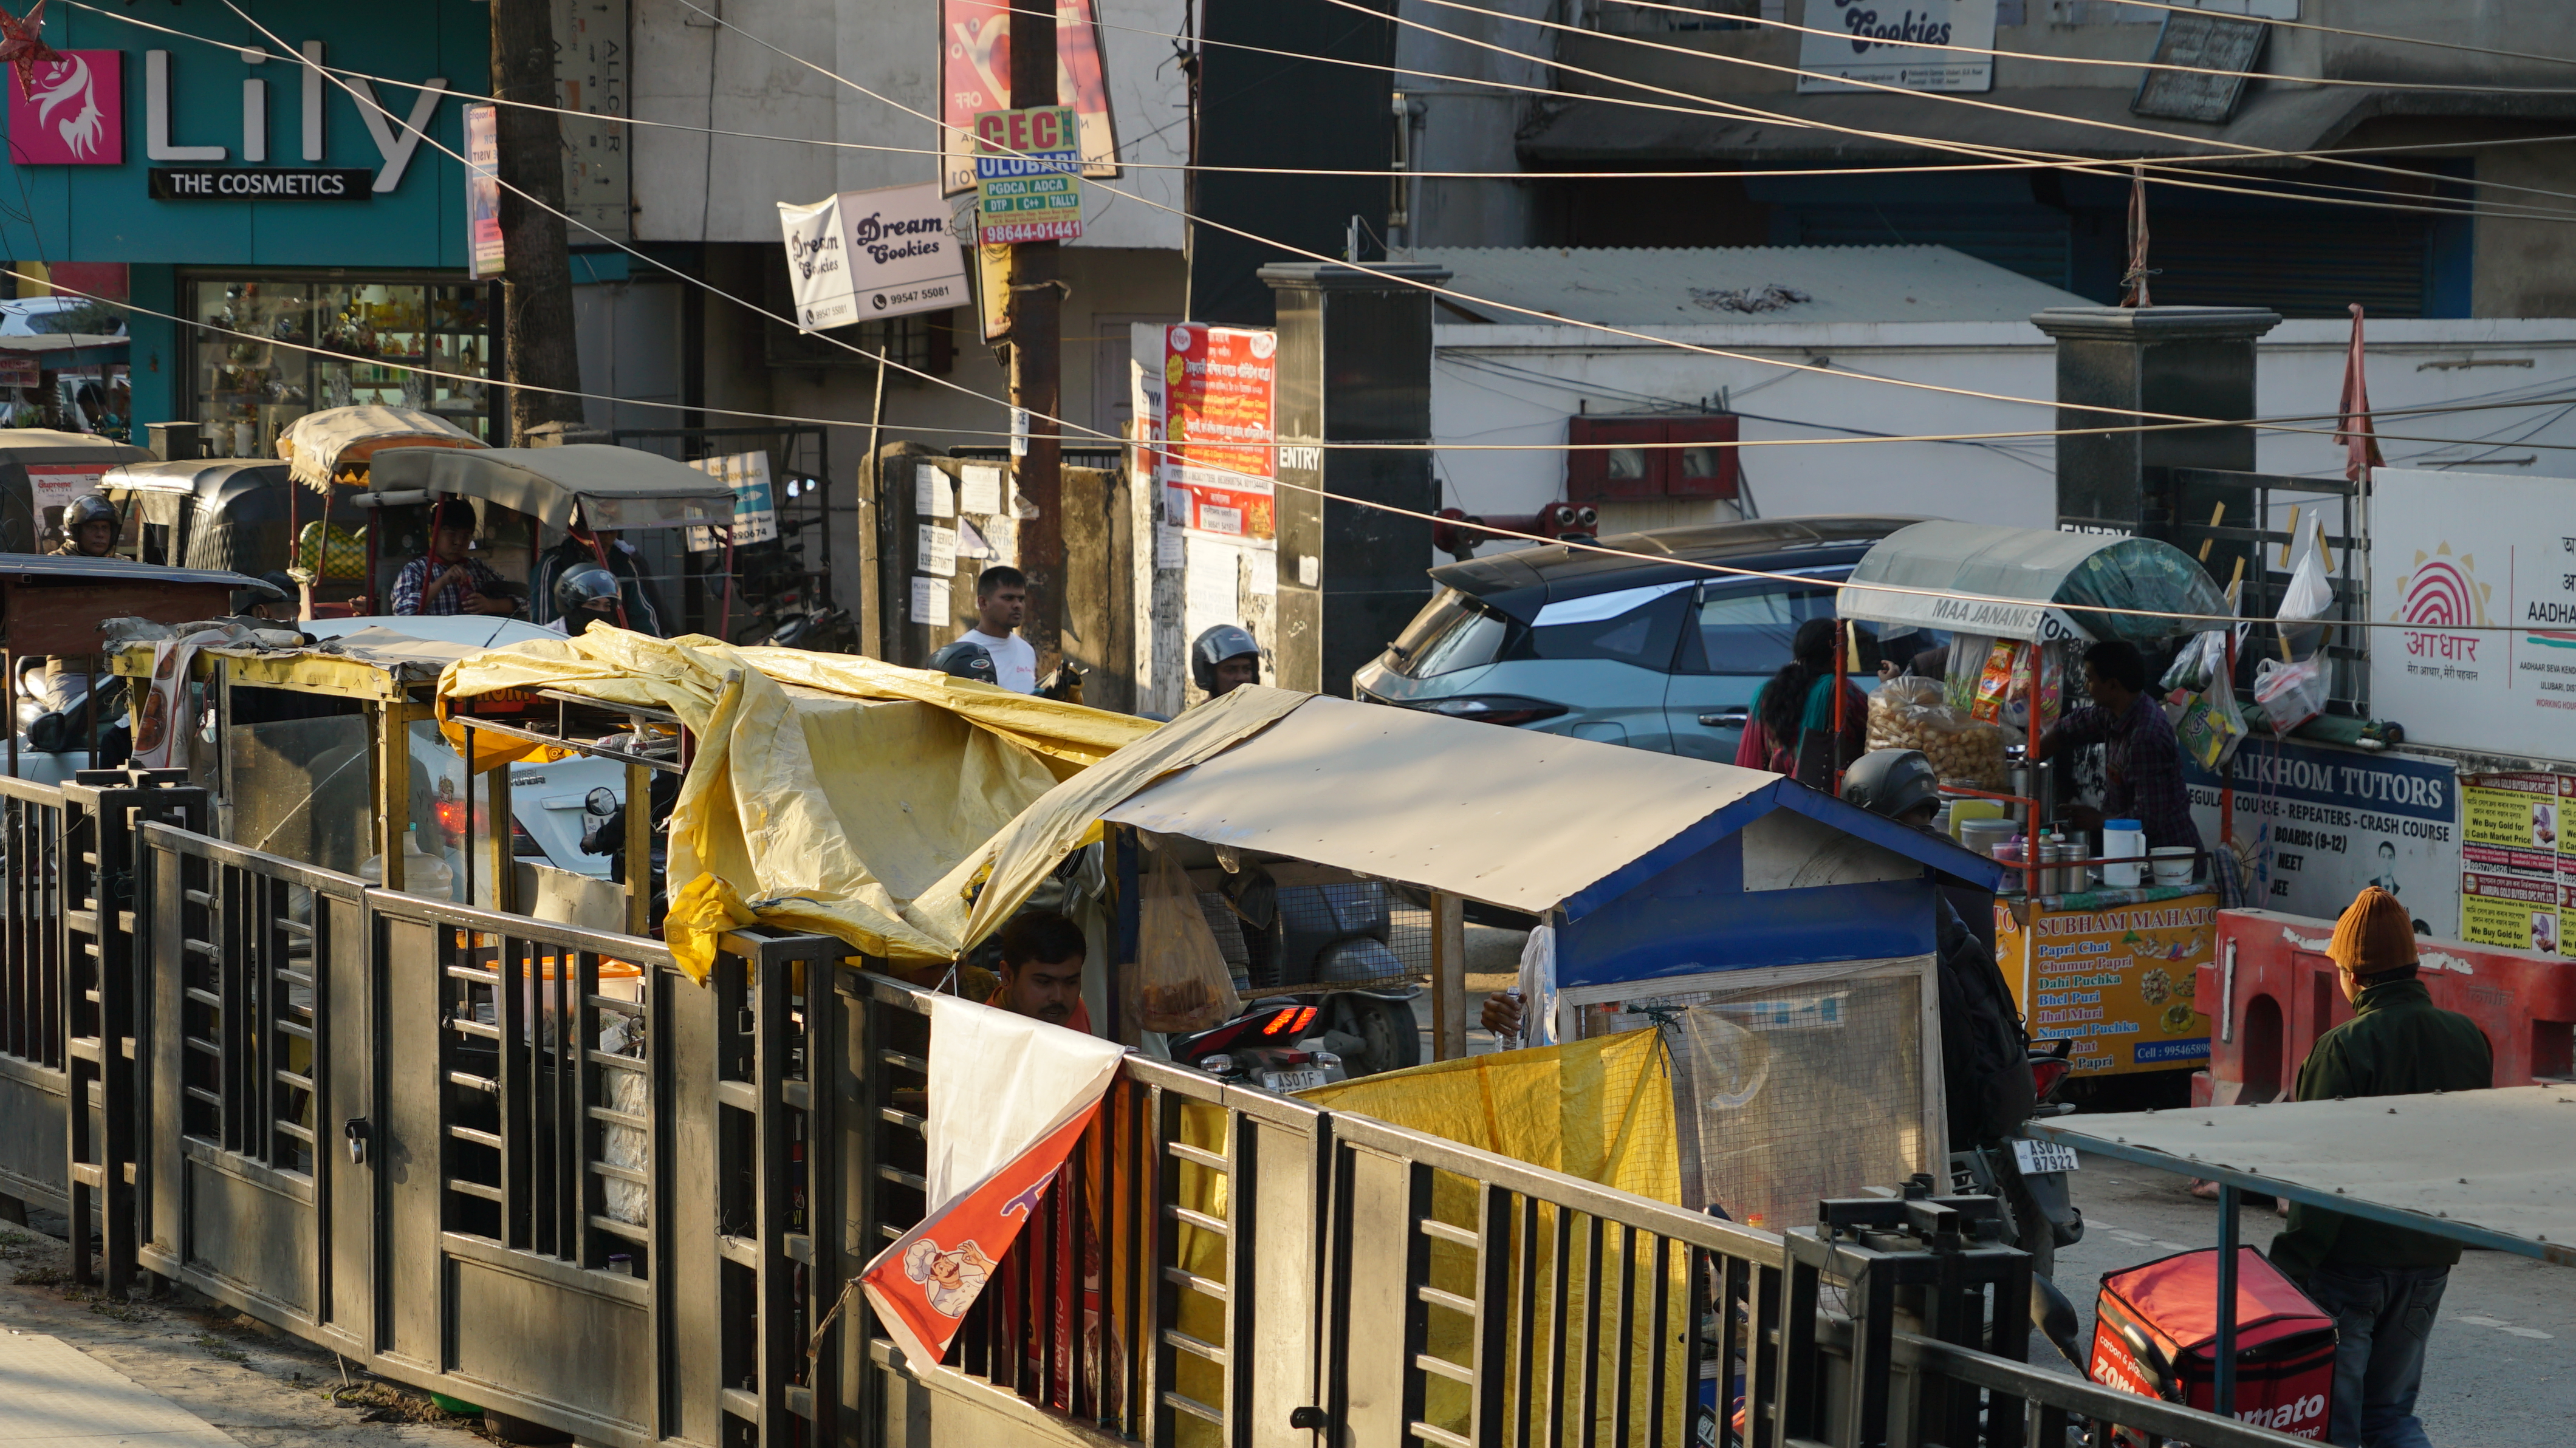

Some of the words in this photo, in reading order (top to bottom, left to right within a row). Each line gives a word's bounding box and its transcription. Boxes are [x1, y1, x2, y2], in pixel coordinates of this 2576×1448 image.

[1845, 7, 1952, 54] Cookies
[608, 39, 620, 152] ALLCOR
[146, 40, 448, 193] Lily
[979, 111, 1057, 152] CEC
[981, 152, 1077, 177] ULUBARI
[171, 173, 213, 194] THE
[218, 174, 344, 194] COSMETICS
[988, 182, 1026, 195] PGDCA
[1033, 179, 1064, 192] ADCA
[990, 199, 1007, 211] DTP
[1023, 198, 1039, 210] C++
[1050, 194, 1076, 207] TALLY
[857, 211, 943, 247] Dream
[987, 220, 1081, 242] 98644-01441
[792, 230, 838, 261] Dream
[867, 240, 940, 264] Cookies
[799, 257, 838, 279] Cookies
[890, 289, 918, 305] 99547
[922, 285, 950, 300] 55081
[711, 463, 727, 473] NO
[1279, 446, 1321, 471] ENTRY
[38, 479, 72, 490] Supreme
[718, 468, 763, 482] ARKING
[937, 531, 954, 547] SERVICE
[1932, 598, 1970, 621] MAA
[1970, 604, 2026, 627] JANANI
[2404, 631, 2480, 662] आधार
[2407, 661, 2419, 675] मेरा
[2444, 664, 2455, 679] मेरी
[2456, 670, 2478, 681] पहचान
[2520, 661, 2546, 672] AADHAAR
[2546, 664, 2561, 673] SEVA
[2540, 681, 2565, 692] ULUBARI,
[2536, 698, 2562, 709] WORKING
[2340, 765, 2444, 809] TUTORS
[2501, 779, 2511, 790] GOLD
[2512, 779, 2529, 791] BUYERS
[2529, 782, 2538, 793] OPC
[2235, 795, 2280, 816] COURSE
[2288, 803, 2351, 827] REPEATERS
[2360, 813, 2399, 835] CRASH
[2402, 820, 2450, 842] COURSE
[2472, 818, 2483, 827] We
[2484, 818, 2497, 830] Buy
[2498, 820, 2513, 830] Gold
[2515, 821, 2525, 832] for
[2275, 826, 2314, 847] BOARDS
[2314, 832, 2348, 854] (9-12)
[2471, 828, 2488, 839] Cash
[2489, 830, 2513, 842] Market
[2514, 834, 2532, 844] Price
[2278, 852, 2304, 872] NEET
[2470, 861, 2508, 874] 9957704526
[2270, 878, 2289, 897] JEE
[2480, 885, 2499, 897] KAMRUPA
[2499, 887, 2511, 898] GOLD
[2511, 888, 2528, 900] BUYERS
[2528, 890, 2537, 901] OPC
[2537, 892, 2546, 903] PVT.
[2546, 893, 2556, 904] LTD.
[2037, 912, 2126, 938] SUBHAM
[2471, 926, 2481, 935] We
[2482, 927, 2496, 938] Buy
[2497, 928, 2512, 938] Gold
[2513, 931, 2524, 940] for
[2038, 943, 2075, 958] Papri
[2078, 940, 2111, 954] Chat
[2561, 938, 2573, 948] We
[2038, 959, 2095, 974] Chumur
[2097, 955, 2134, 972] Papri
[2038, 977, 2070, 991] Dahi
[2073, 973, 2122, 988] Puchka
[2038, 993, 2069, 1008] Bhel
[2071, 990, 2101, 1005] Puri
[2037, 1010, 2066, 1024] Jhal
[2069, 1006, 2103, 1021] Muri
[2037, 1025, 2089, 1040] Normal
[2091, 1020, 2140, 1036] Puchka
[2076, 1055, 2114, 1071] Papri
[2137, 1047, 2157, 1060] Cell
[1278, 1071, 1314, 1088] AS01F
[2032, 1155, 2074, 1172] B7922
[1053, 1294, 1068, 1383] Chicken
[2099, 1334, 2123, 1361] carbon
[2122, 1354, 2128, 1365] &
